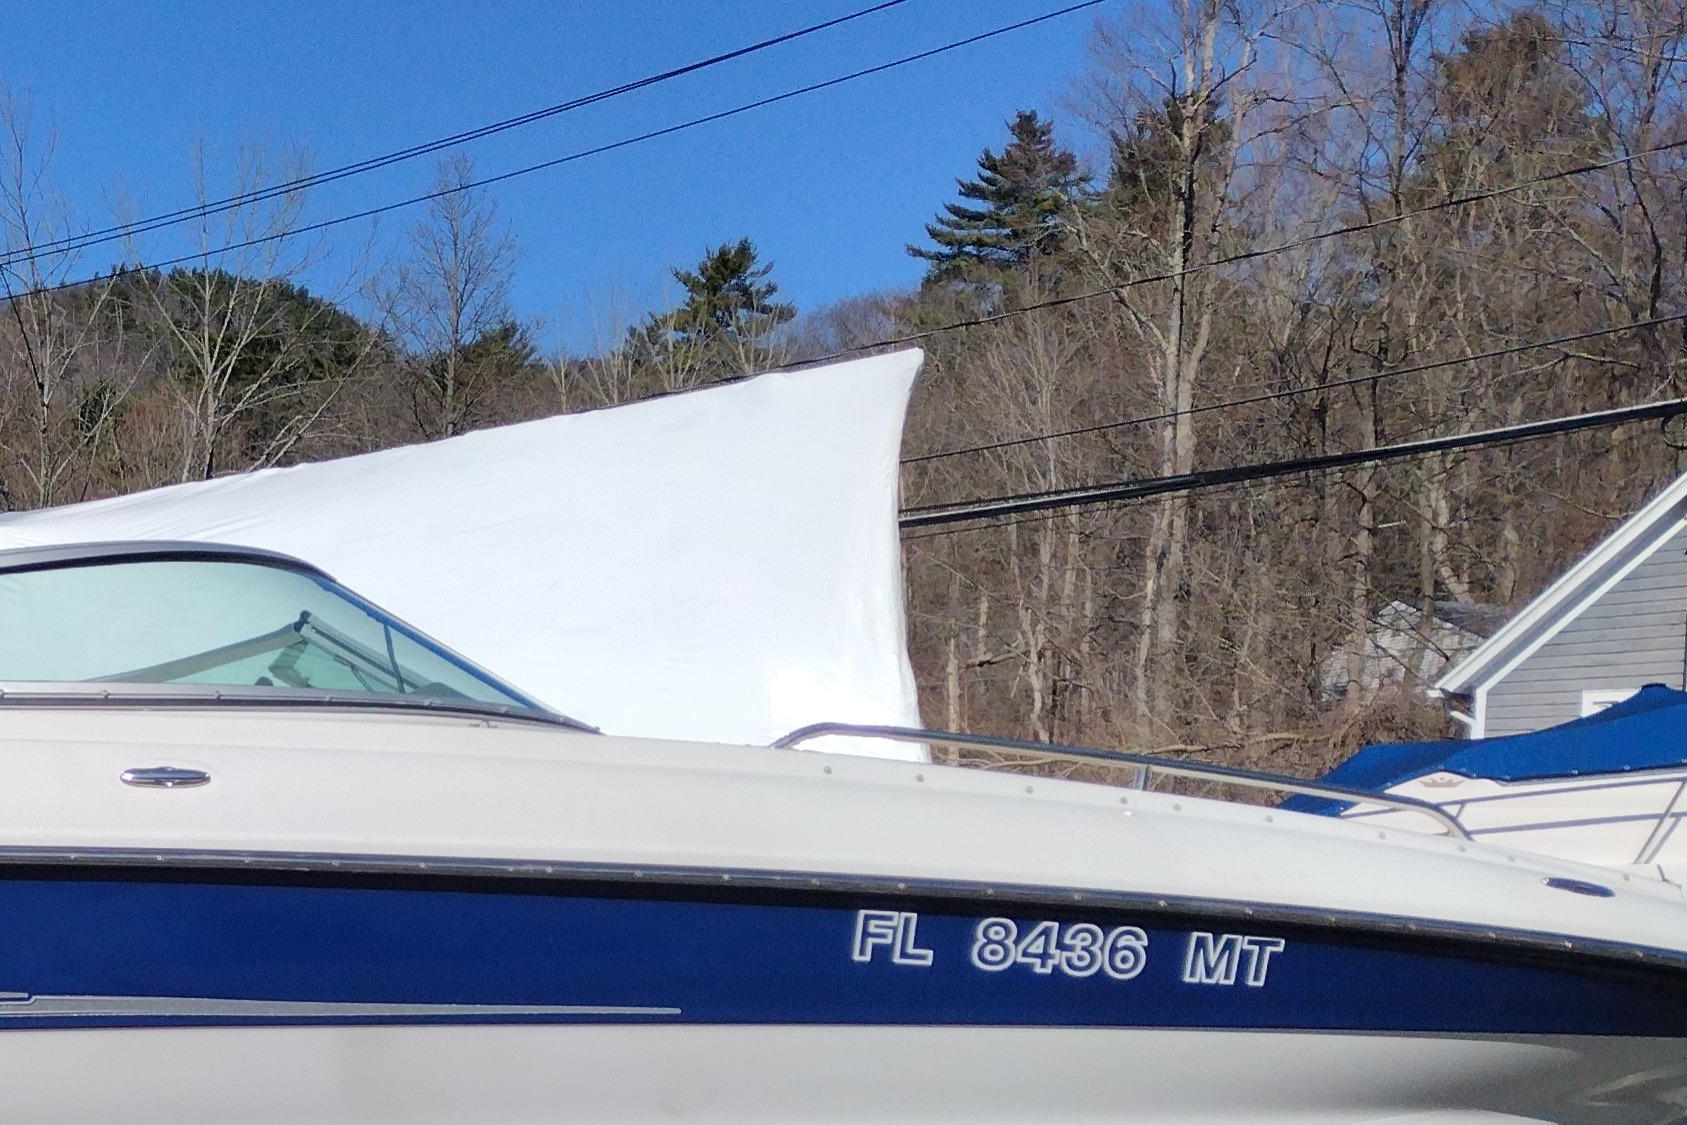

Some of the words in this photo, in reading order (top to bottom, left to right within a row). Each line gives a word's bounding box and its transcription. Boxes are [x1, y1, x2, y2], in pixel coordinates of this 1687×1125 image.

[852, 910, 933, 966] FL
[972, 917, 1148, 980] 8436
[1183, 932, 1285, 987] MT
